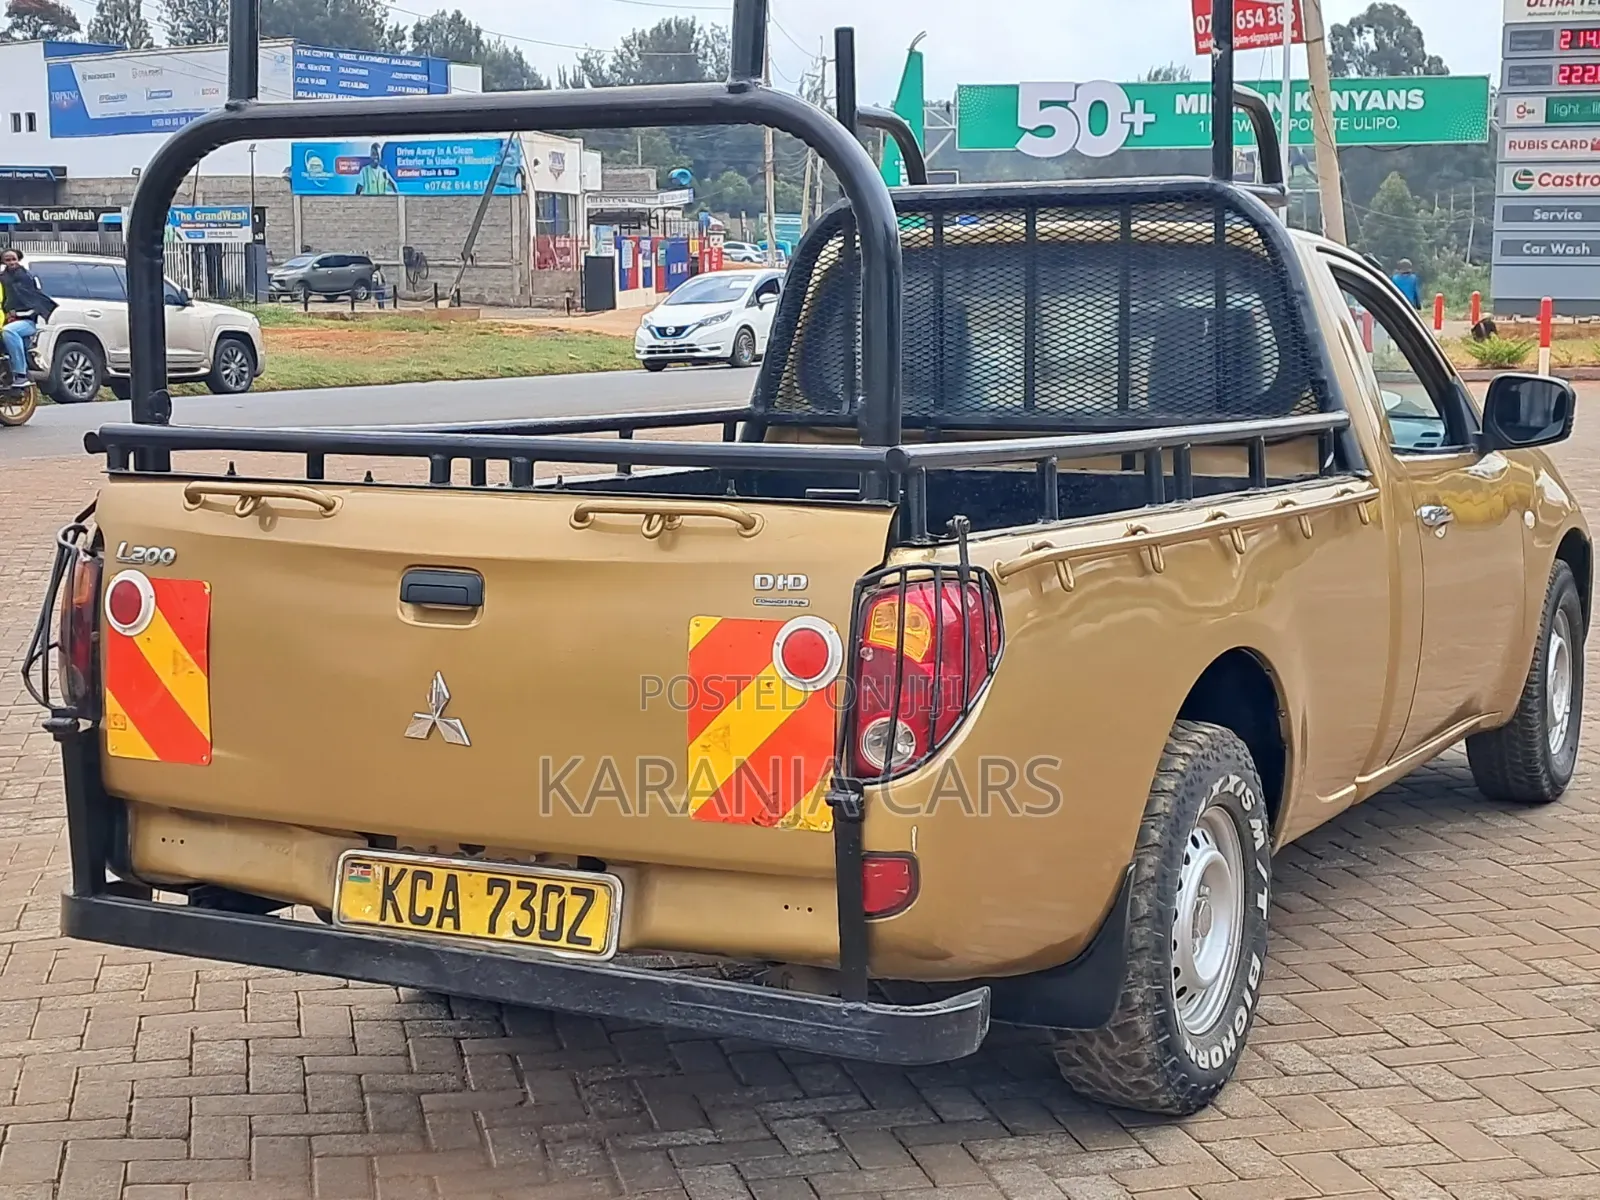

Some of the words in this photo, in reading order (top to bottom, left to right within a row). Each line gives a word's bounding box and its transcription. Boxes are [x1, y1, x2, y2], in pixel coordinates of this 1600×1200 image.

[1236, 8, 1265, 30] 654
[1294, 89, 1424, 112] KNYANS
[1553, 103, 1580, 117] light
[1014, 80, 1156, 157] 50+
[1354, 116, 1400, 130] ULIPO.
[1508, 140, 1548, 150] RUBIS
[1551, 139, 1588, 150] CARD
[396, 148, 415, 156] Drive
[416, 147, 436, 157] Away
[453, 146, 474, 154] Clean
[396, 157, 425, 166] Exterior
[426, 157, 434, 165] In
[435, 157, 458, 165] Under
[397, 169, 420, 177] Exterior
[430, 181, 452, 191] 0742
[23, 210, 41, 221] The
[42, 209, 95, 221] GrandWash
[174, 211, 193, 220] The
[194, 209, 249, 221] GrandWash
[1533, 208, 1582, 220] Service
[1522, 243, 1547, 254] Car
[1550, 242, 1591, 255] Wash
[116, 541, 177, 566] L200
[380, 865, 462, 931] KCA
[485, 876, 596, 947] 730Z
[1183, 951, 1262, 1071] BIGHORN
